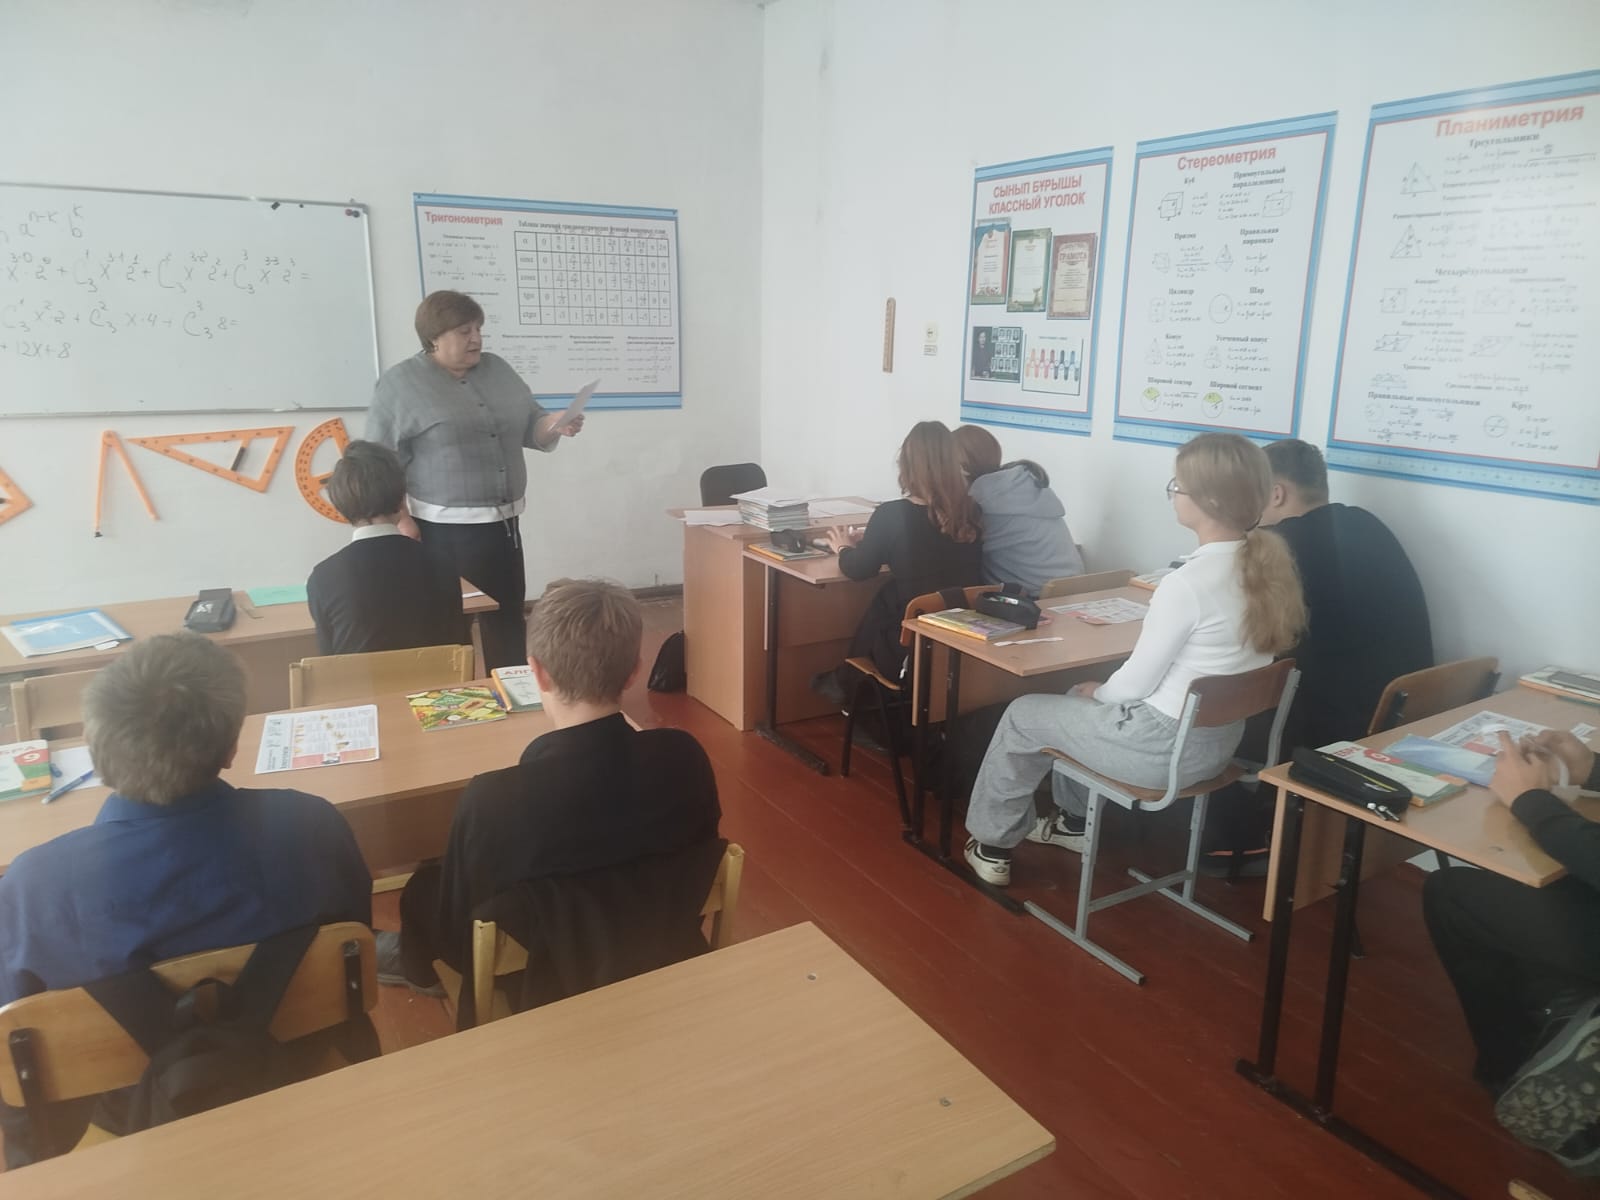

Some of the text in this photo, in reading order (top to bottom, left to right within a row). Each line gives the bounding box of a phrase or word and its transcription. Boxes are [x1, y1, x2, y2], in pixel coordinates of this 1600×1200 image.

[1435, 106, 1584, 136] Планиметрия
[1177, 147, 1277, 171] Стереометрия
[993, 182, 1030, 198] СЫНЫП
[989, 191, 1086, 215] КЛАССНЫЙ УГОЛОК
[424, 211, 503, 226] Тригонометрия
[1511, 401, 1533, 412] Круг
